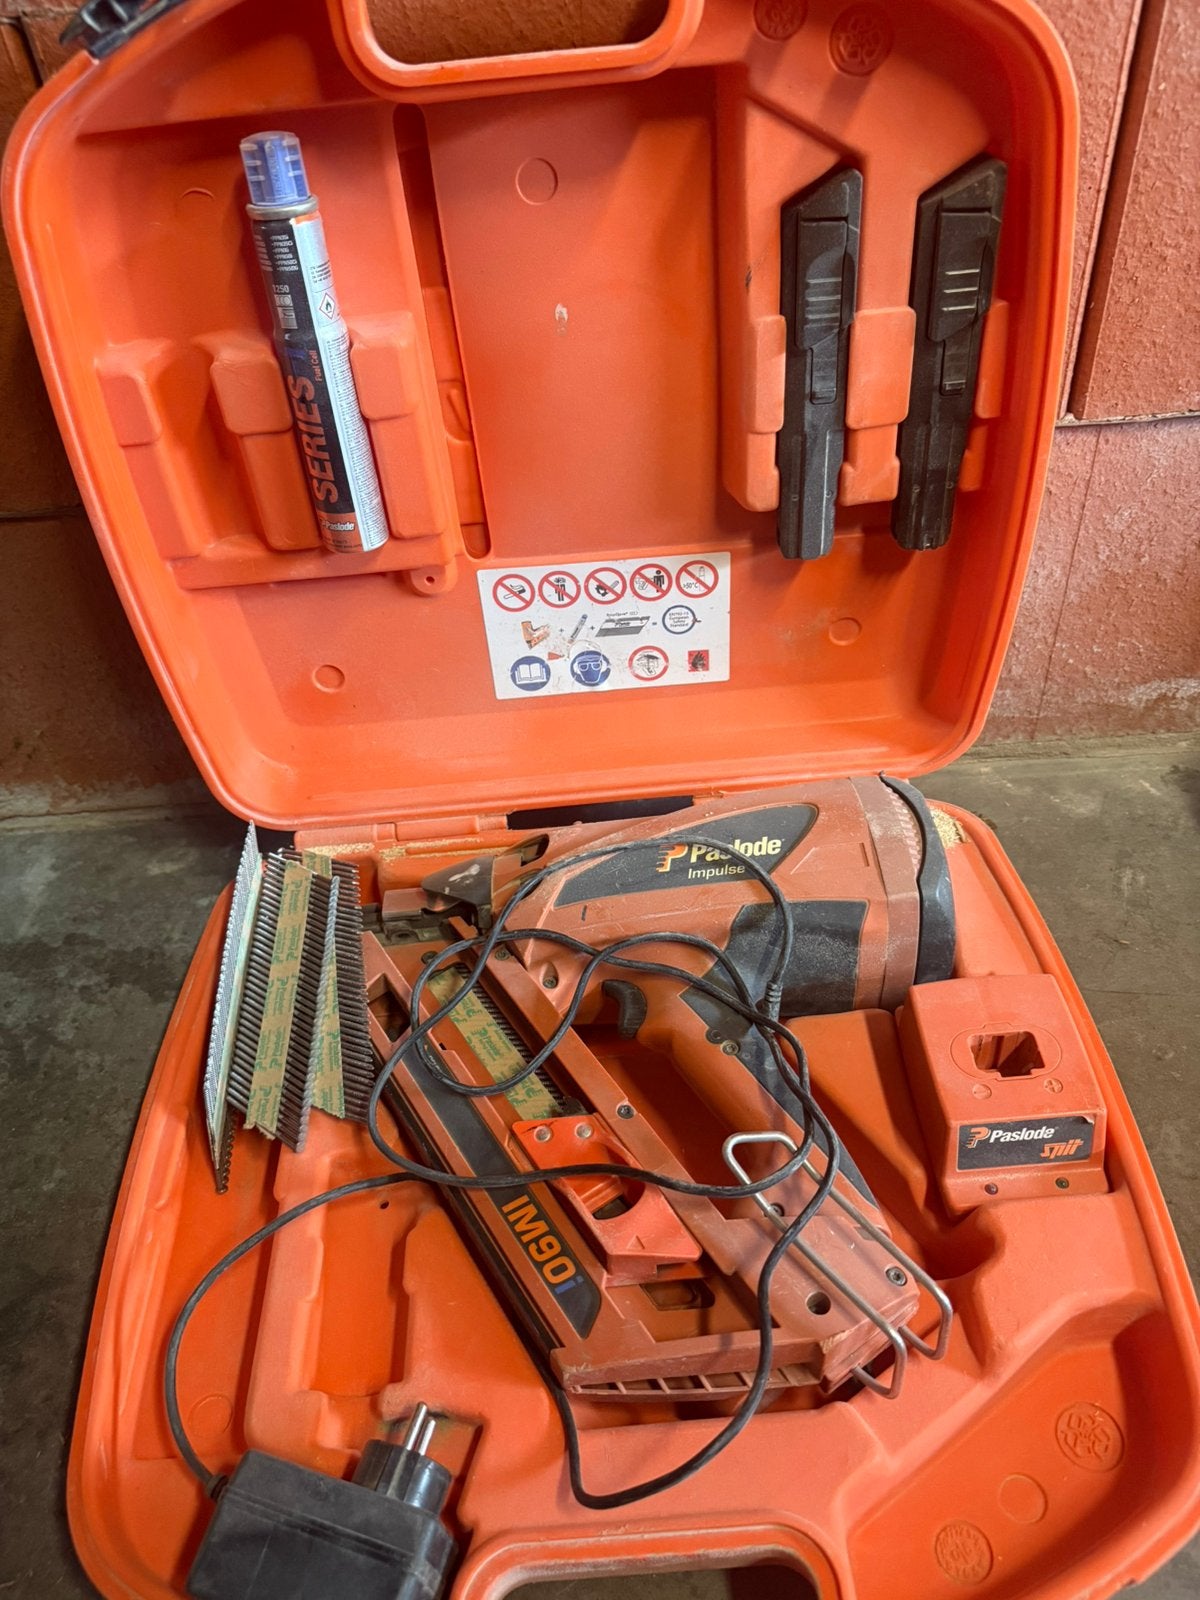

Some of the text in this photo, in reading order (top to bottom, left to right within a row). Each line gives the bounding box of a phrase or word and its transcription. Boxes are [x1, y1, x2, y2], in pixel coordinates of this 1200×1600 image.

[272, 284, 290, 293] 1250
[308, 349, 323, 382] Fuel Cell
[286, 374, 340, 506] SERIES
[325, 520, 355, 532] Paslode
[687, 863, 746, 880] Impulse
[989, 1125, 1056, 1144] Paslode
[501, 1194, 585, 1295] IM90i
